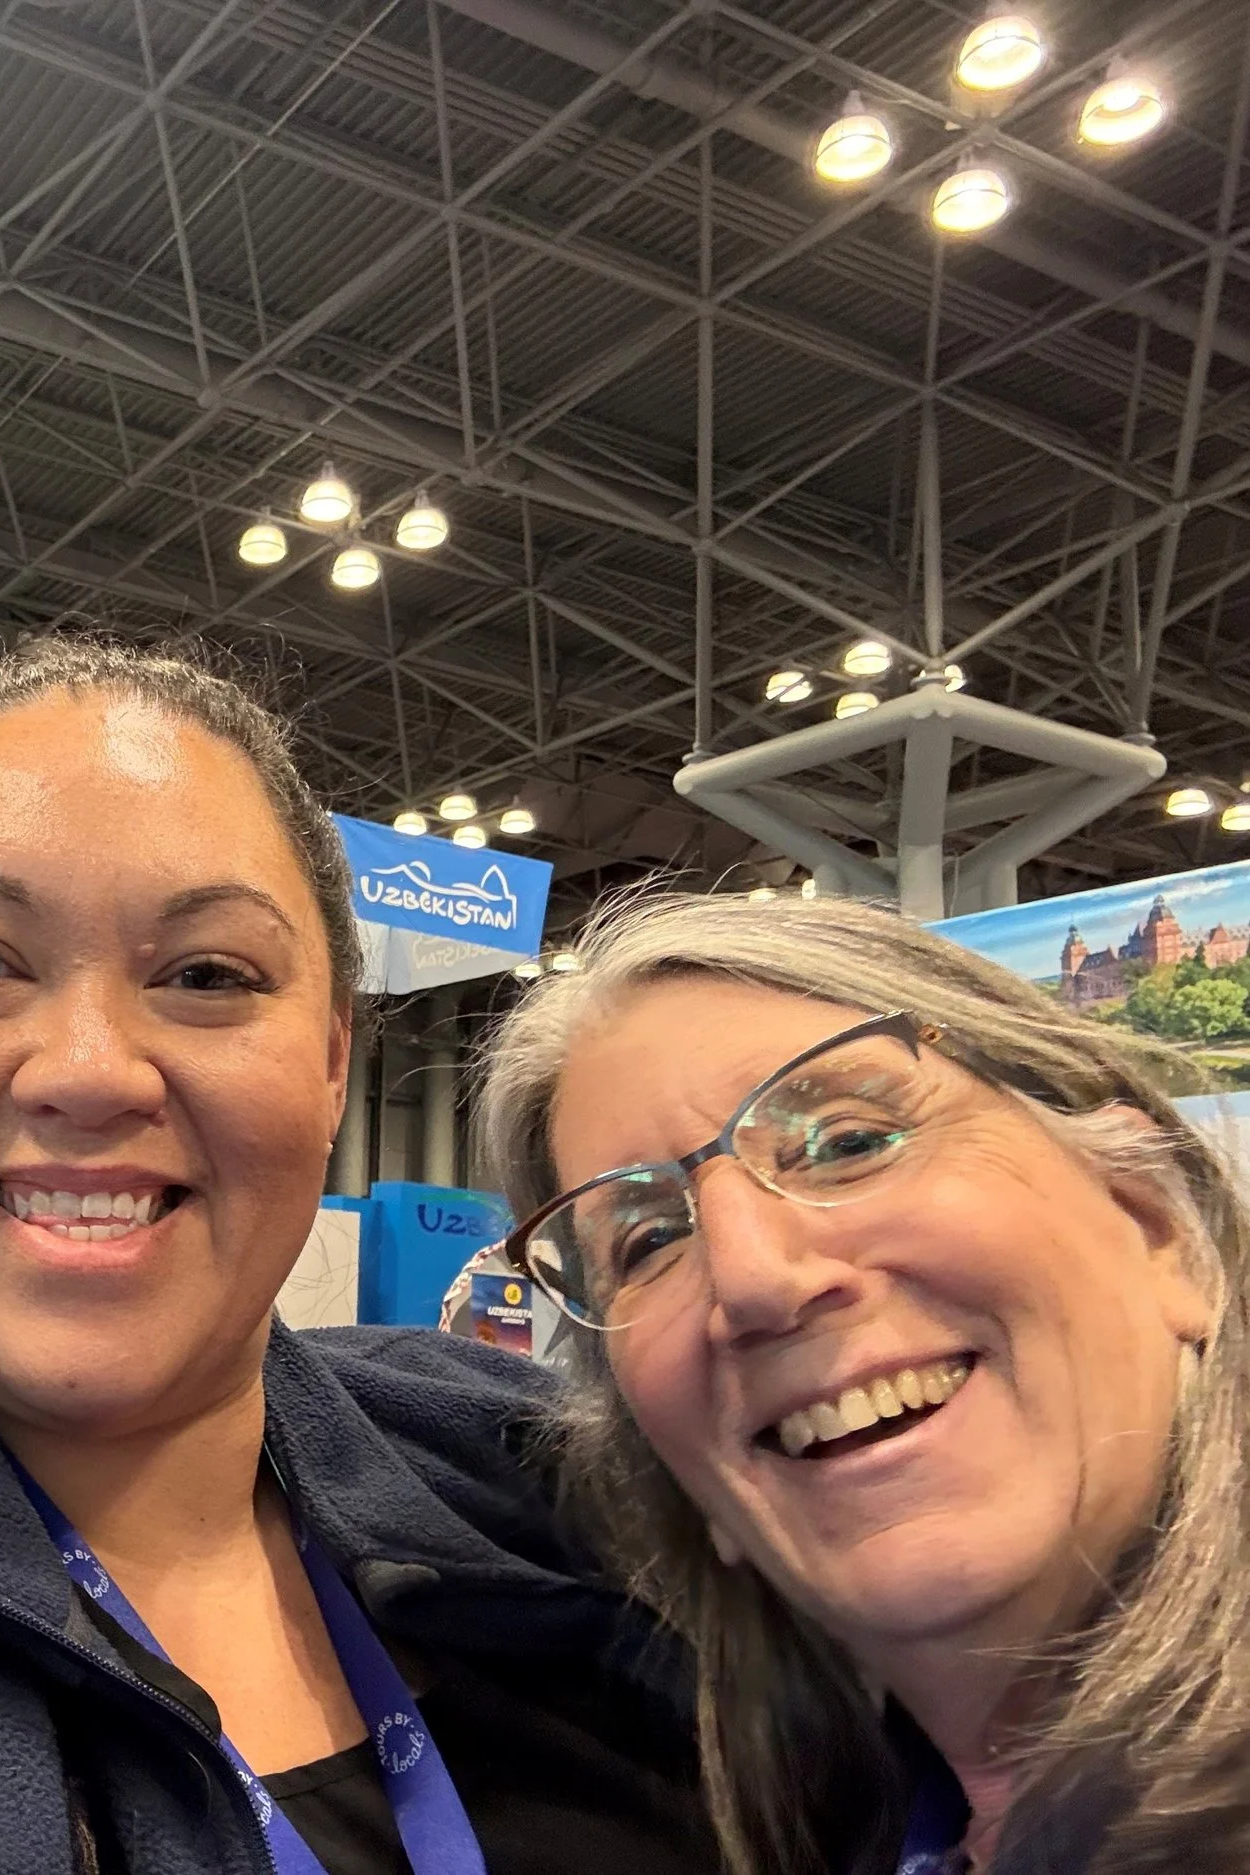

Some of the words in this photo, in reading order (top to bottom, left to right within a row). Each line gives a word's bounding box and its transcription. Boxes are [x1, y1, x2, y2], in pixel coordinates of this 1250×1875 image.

[360, 874, 513, 930] UZBEKISTAN
[487, 1305, 533, 1319] UZBEKISTA
[83, 1566, 110, 1599] locals
[394, 1712, 411, 1727] BY
[390, 1730, 426, 1775] locals
[255, 1790, 273, 1825] cals
